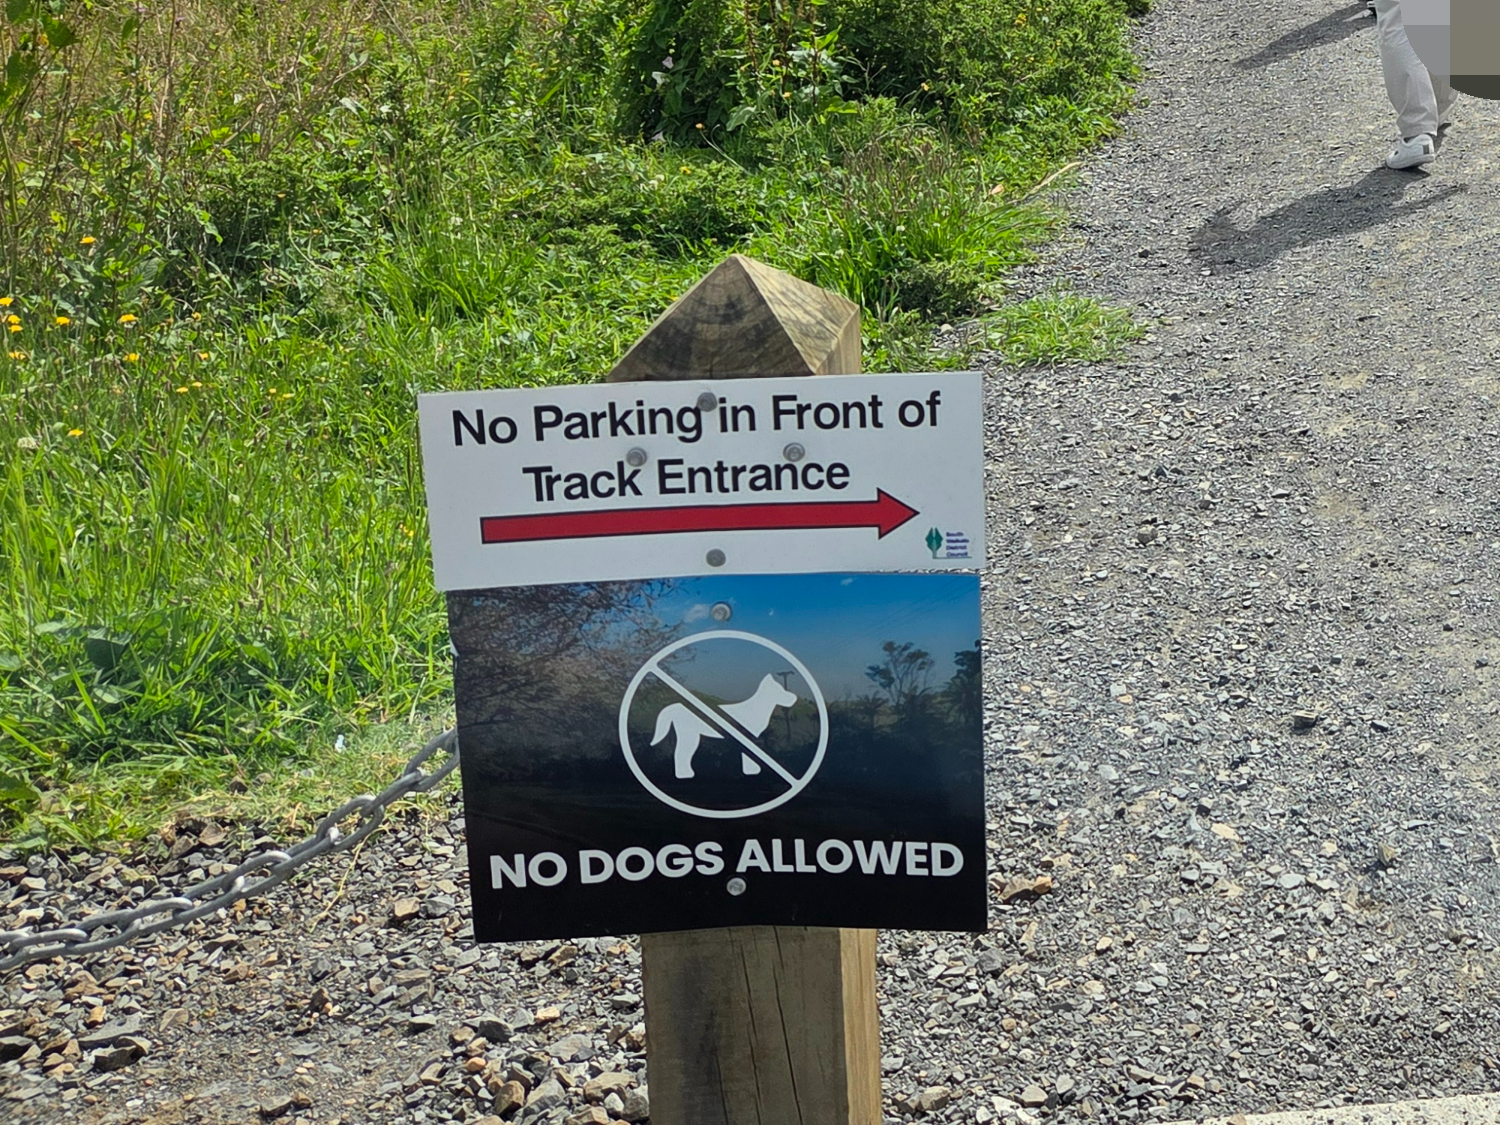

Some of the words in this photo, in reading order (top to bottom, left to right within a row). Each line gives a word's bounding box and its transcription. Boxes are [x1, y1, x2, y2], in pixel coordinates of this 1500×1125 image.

[452, 409, 518, 447] No
[533, 398, 704, 444] Parking
[718, 397, 756, 433] in
[772, 394, 884, 431] Front
[898, 390, 941, 428] of
[522, 460, 643, 502] Track
[657, 458, 850, 495] Entrance
[490, 852, 568, 889] NO
[579, 841, 725, 884] DOGS
[736, 838, 965, 876] ALLOWED
